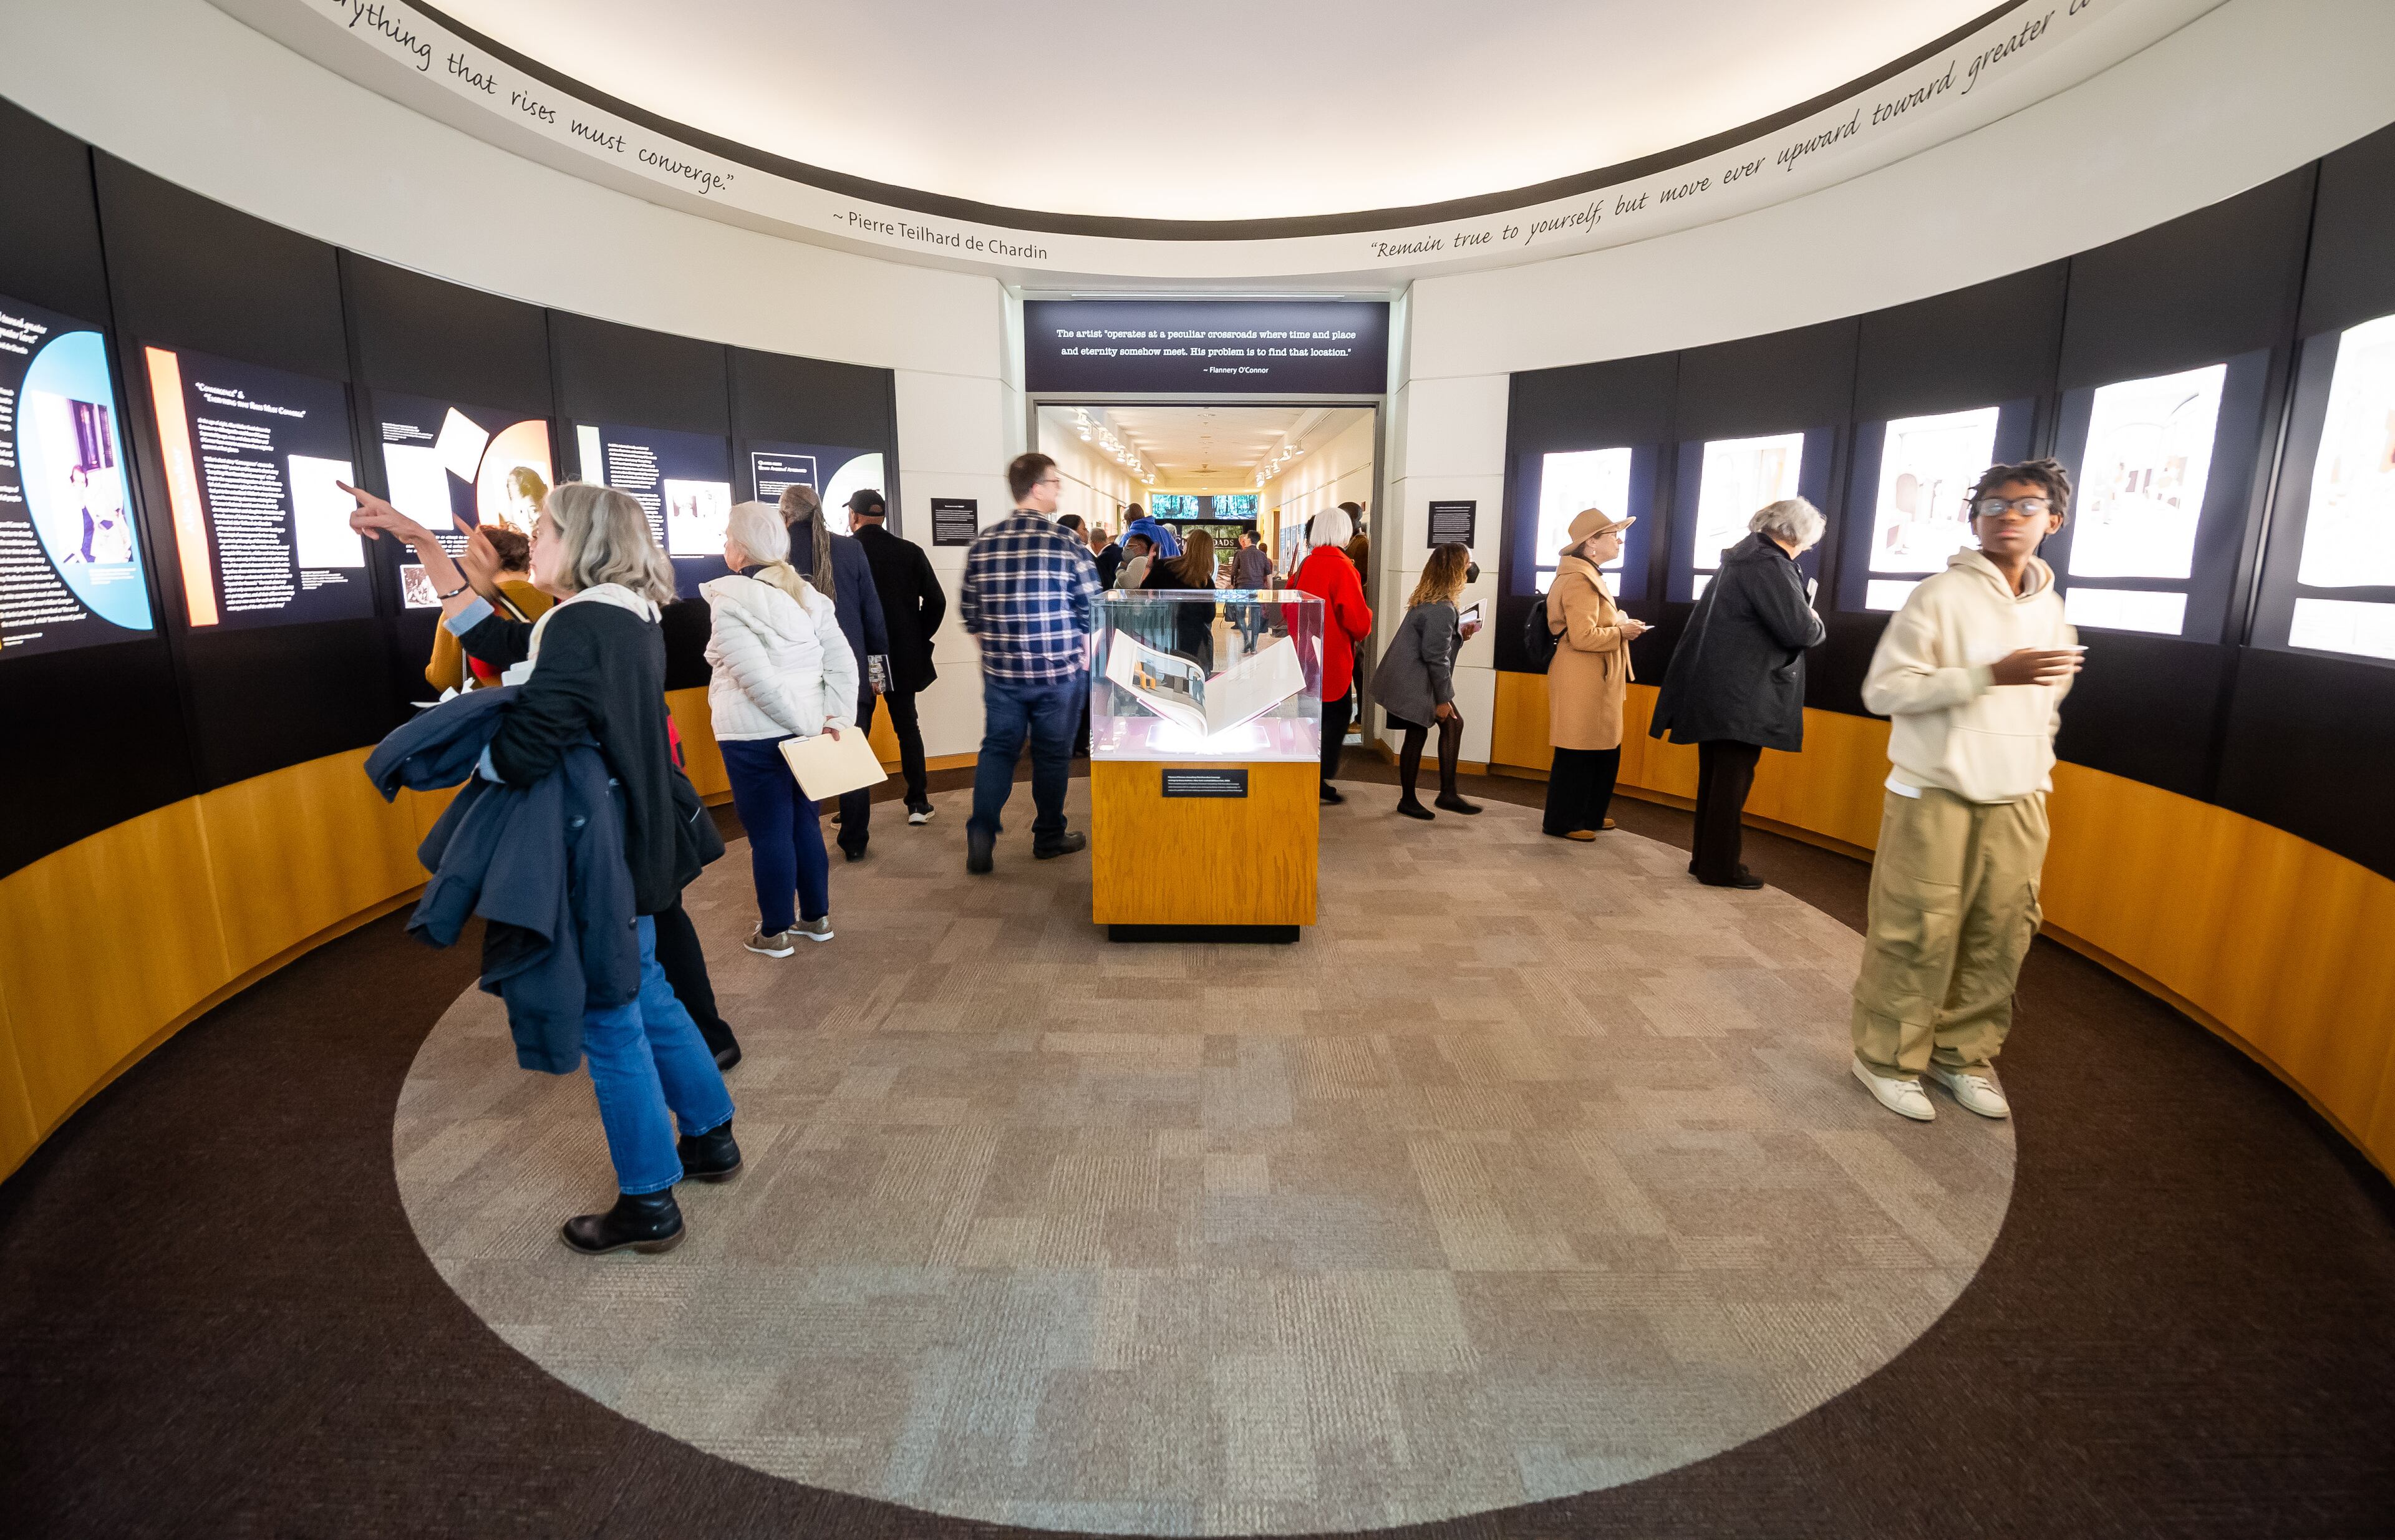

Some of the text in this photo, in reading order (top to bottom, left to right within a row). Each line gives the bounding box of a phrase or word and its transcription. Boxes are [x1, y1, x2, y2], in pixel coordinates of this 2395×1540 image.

[333, 0, 734, 195] ything that rises must converge.”
[1371, 9, 2055, 257] “Remain true to yourself, but move ever upward toward greater
[849, 211, 894, 235] Pierre
[898, 222, 960, 248] Teilhard
[965, 236, 984, 251] de
[989, 240, 1047, 259] Chardin
[1057, 329, 1074, 339] The
[1076, 330, 1103, 339] artist
[1148, 330, 1158, 339] at
[1168, 330, 1206, 340] peculiar
[1207, 330, 1257, 339] crossroads
[1259, 331, 1287, 339] where
[1289, 331, 1310, 339] time
[1312, 331, 1330, 339] and
[1332, 331, 1357, 341] place
[1061, 347, 1079, 356] and
[1080, 347, 1118, 357] eternity
[1120, 347, 1162, 356] somehow
[1163, 348, 1188, 356] meet.
[1190, 347, 1206, 356] His
[1207, 347, 1245, 357] problem
[1246, 347, 1255, 356] is
[1257, 348, 1267, 356] to
[1268, 348, 1287, 356] find
[1289, 348, 1309, 356] that
[1209, 366, 1237, 374] Flannery
